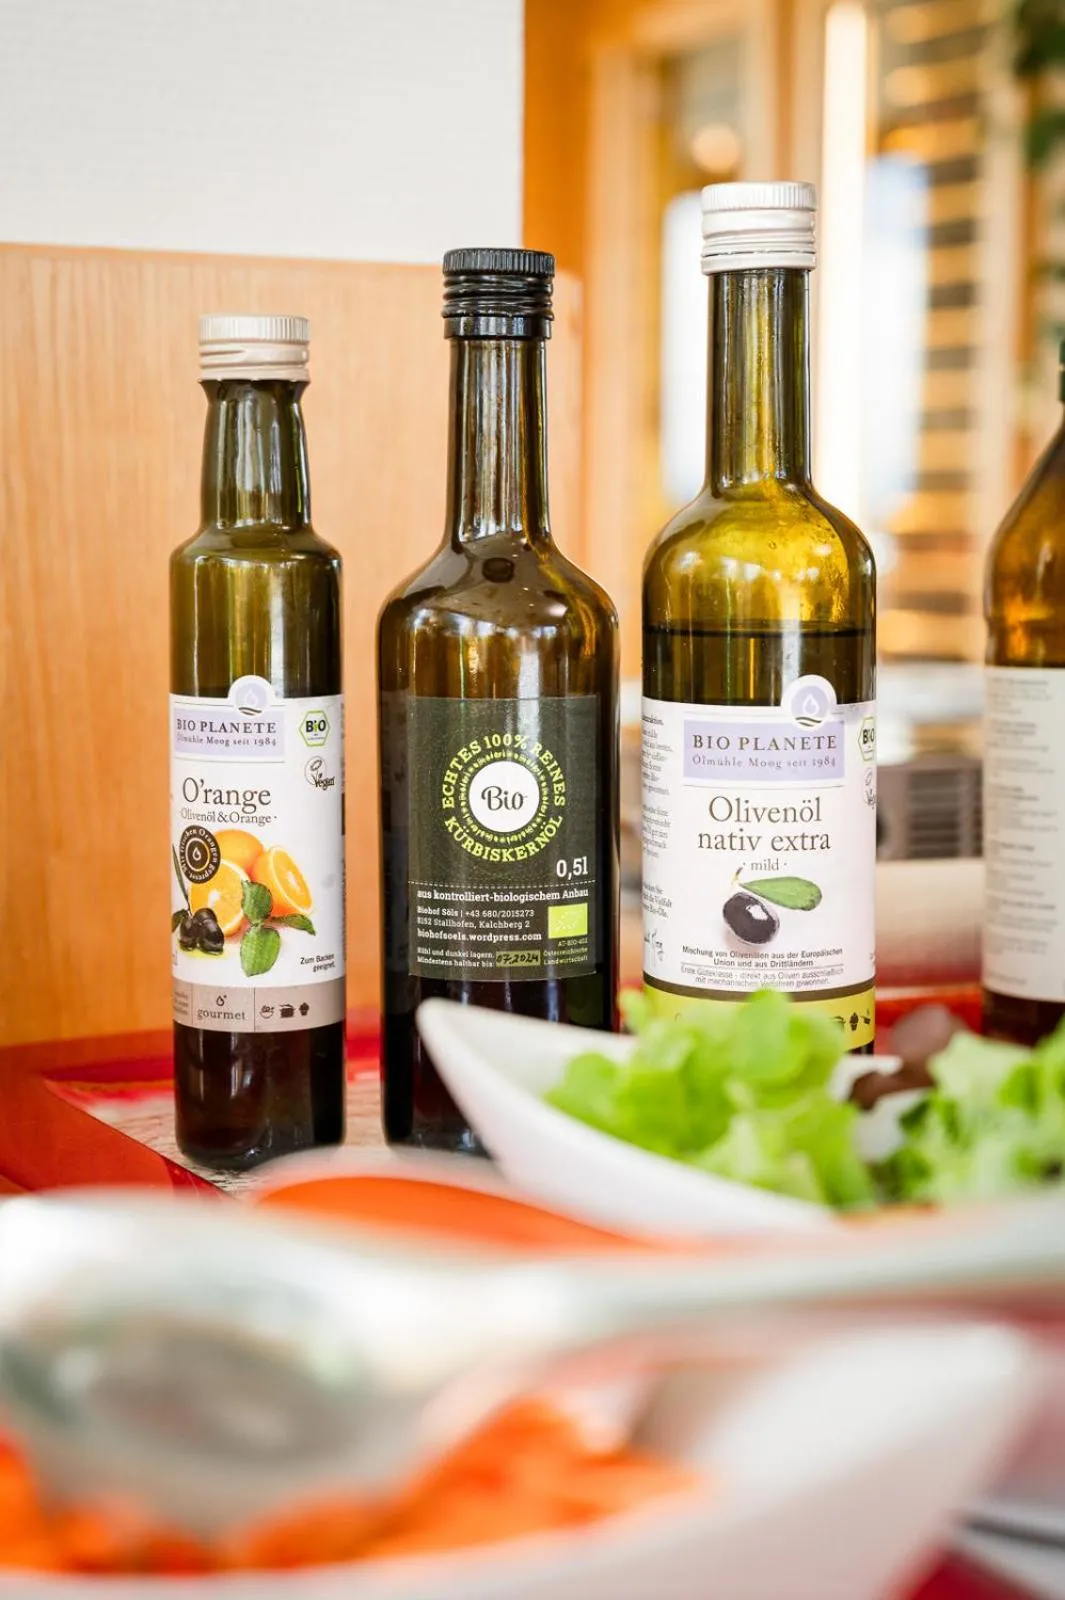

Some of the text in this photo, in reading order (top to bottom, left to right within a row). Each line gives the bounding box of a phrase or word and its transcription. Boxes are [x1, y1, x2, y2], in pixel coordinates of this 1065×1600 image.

[177, 718, 276, 734] BIO PLANETE
[206, 736, 230, 747] Moog
[233, 737, 250, 745] seit
[254, 737, 276, 747] 1984
[693, 734, 730, 750] BIO
[738, 735, 837, 751] PLANETE
[692, 754, 836, 770] Ölmühle Moog seit 1984
[442, 733, 567, 809] ECHTES 100% REINES
[481, 785, 526, 811] Bio
[708, 795, 822, 823] Olivenöl
[444, 815, 564, 862] KÜRBISKERNÖL
[698, 828, 831, 852] nativ extra
[750, 858, 780, 871] mild
[417, 888, 589, 904] aus kontrolliert-biologischem Anbau
[417, 905, 440, 915] Biohof
[442, 908, 458, 917] Söls
[479, 920, 523, 930] Kalchberg
[525, 920, 531, 928] 2
[417, 928, 542, 943] biohofsoels.wordpress.com
[445, 950, 469, 958] dunkel
[682, 945, 714, 958] Mischung
[787, 951, 798, 959] der
[800, 948, 843, 958] Europäischen
[416, 956, 453, 966] Mindestens
[454, 960, 480, 968] haltbar
[714, 958, 736, 966] Union
[754, 960, 768, 968] aus
[770, 959, 814, 968] Drittländern
[197, 1008, 246, 1021] gourmet
